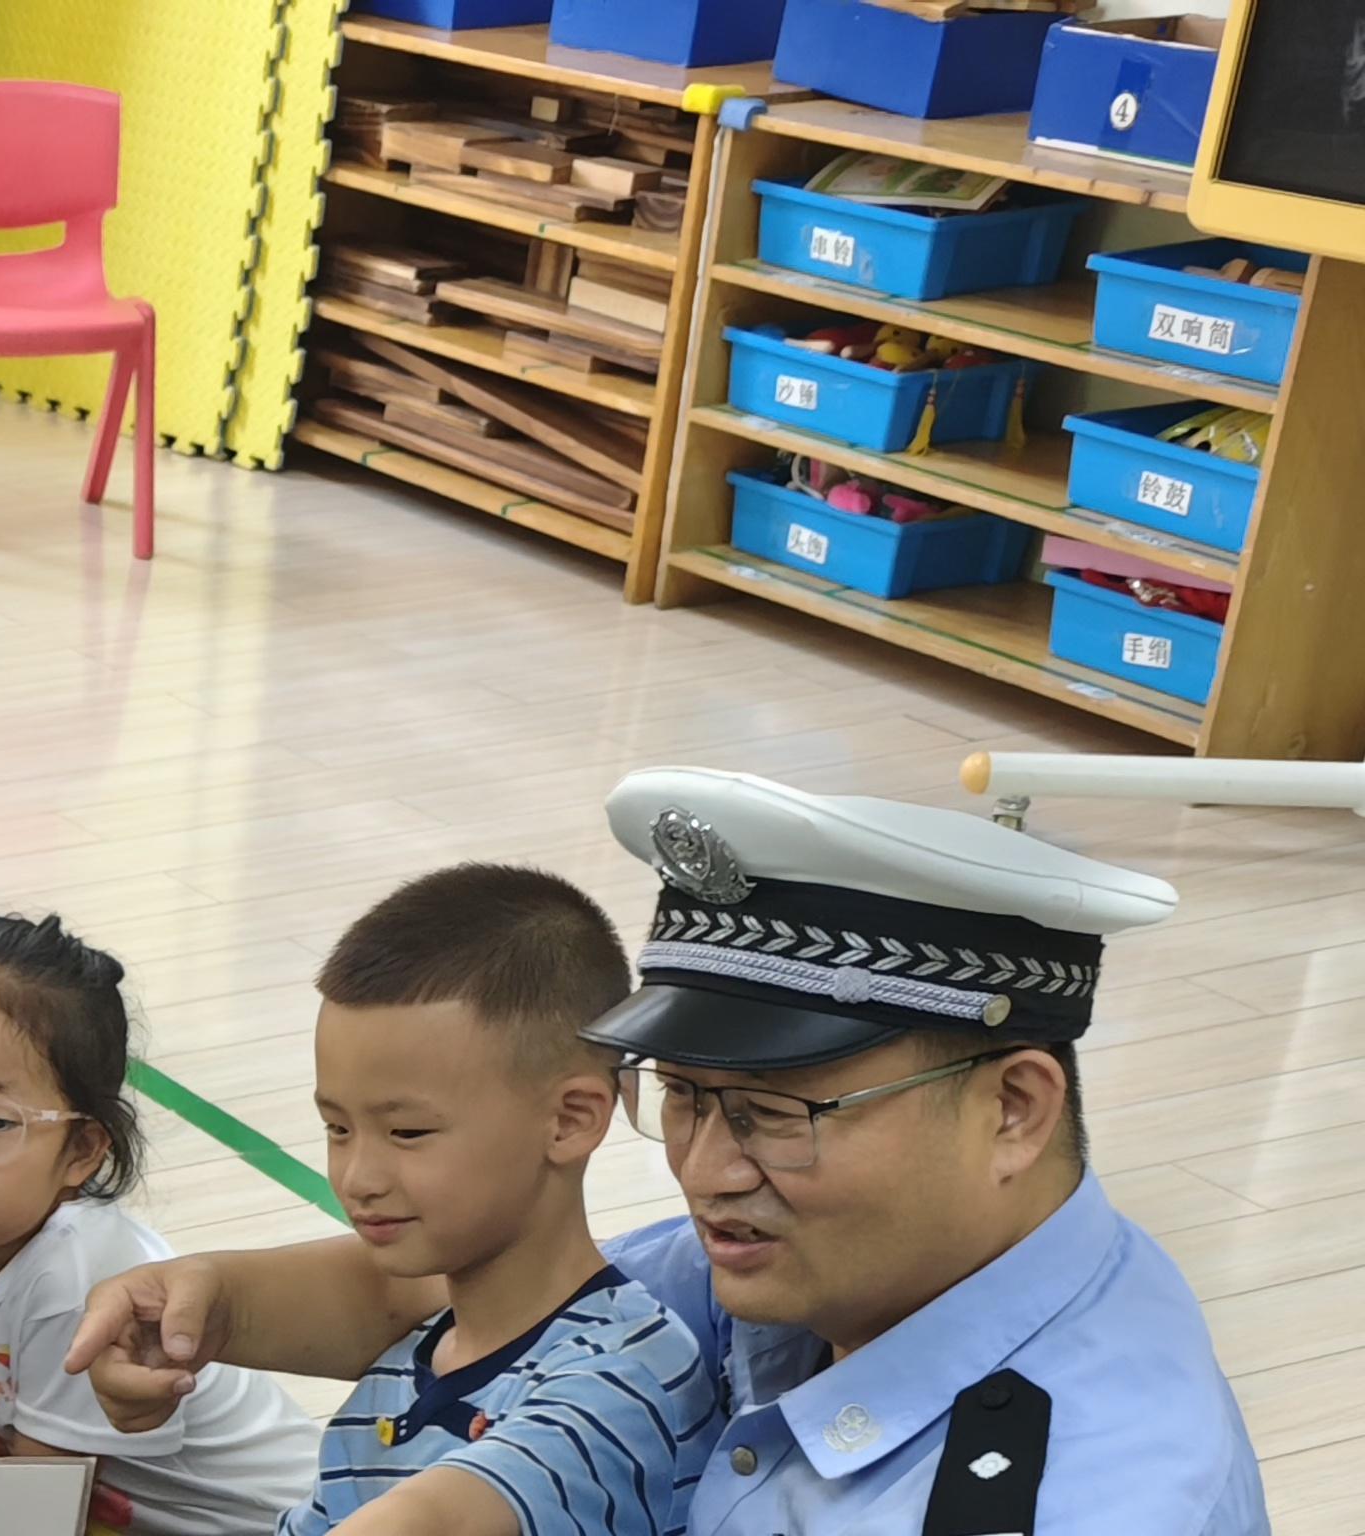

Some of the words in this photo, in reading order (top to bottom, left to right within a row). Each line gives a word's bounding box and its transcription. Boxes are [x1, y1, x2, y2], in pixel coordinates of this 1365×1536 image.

[1115, 98, 1129, 122] 4
[1153, 311, 1230, 349] 双响筒
[1141, 475, 1187, 511] 铃鼓
[1125, 637, 1168, 664] 手绢
